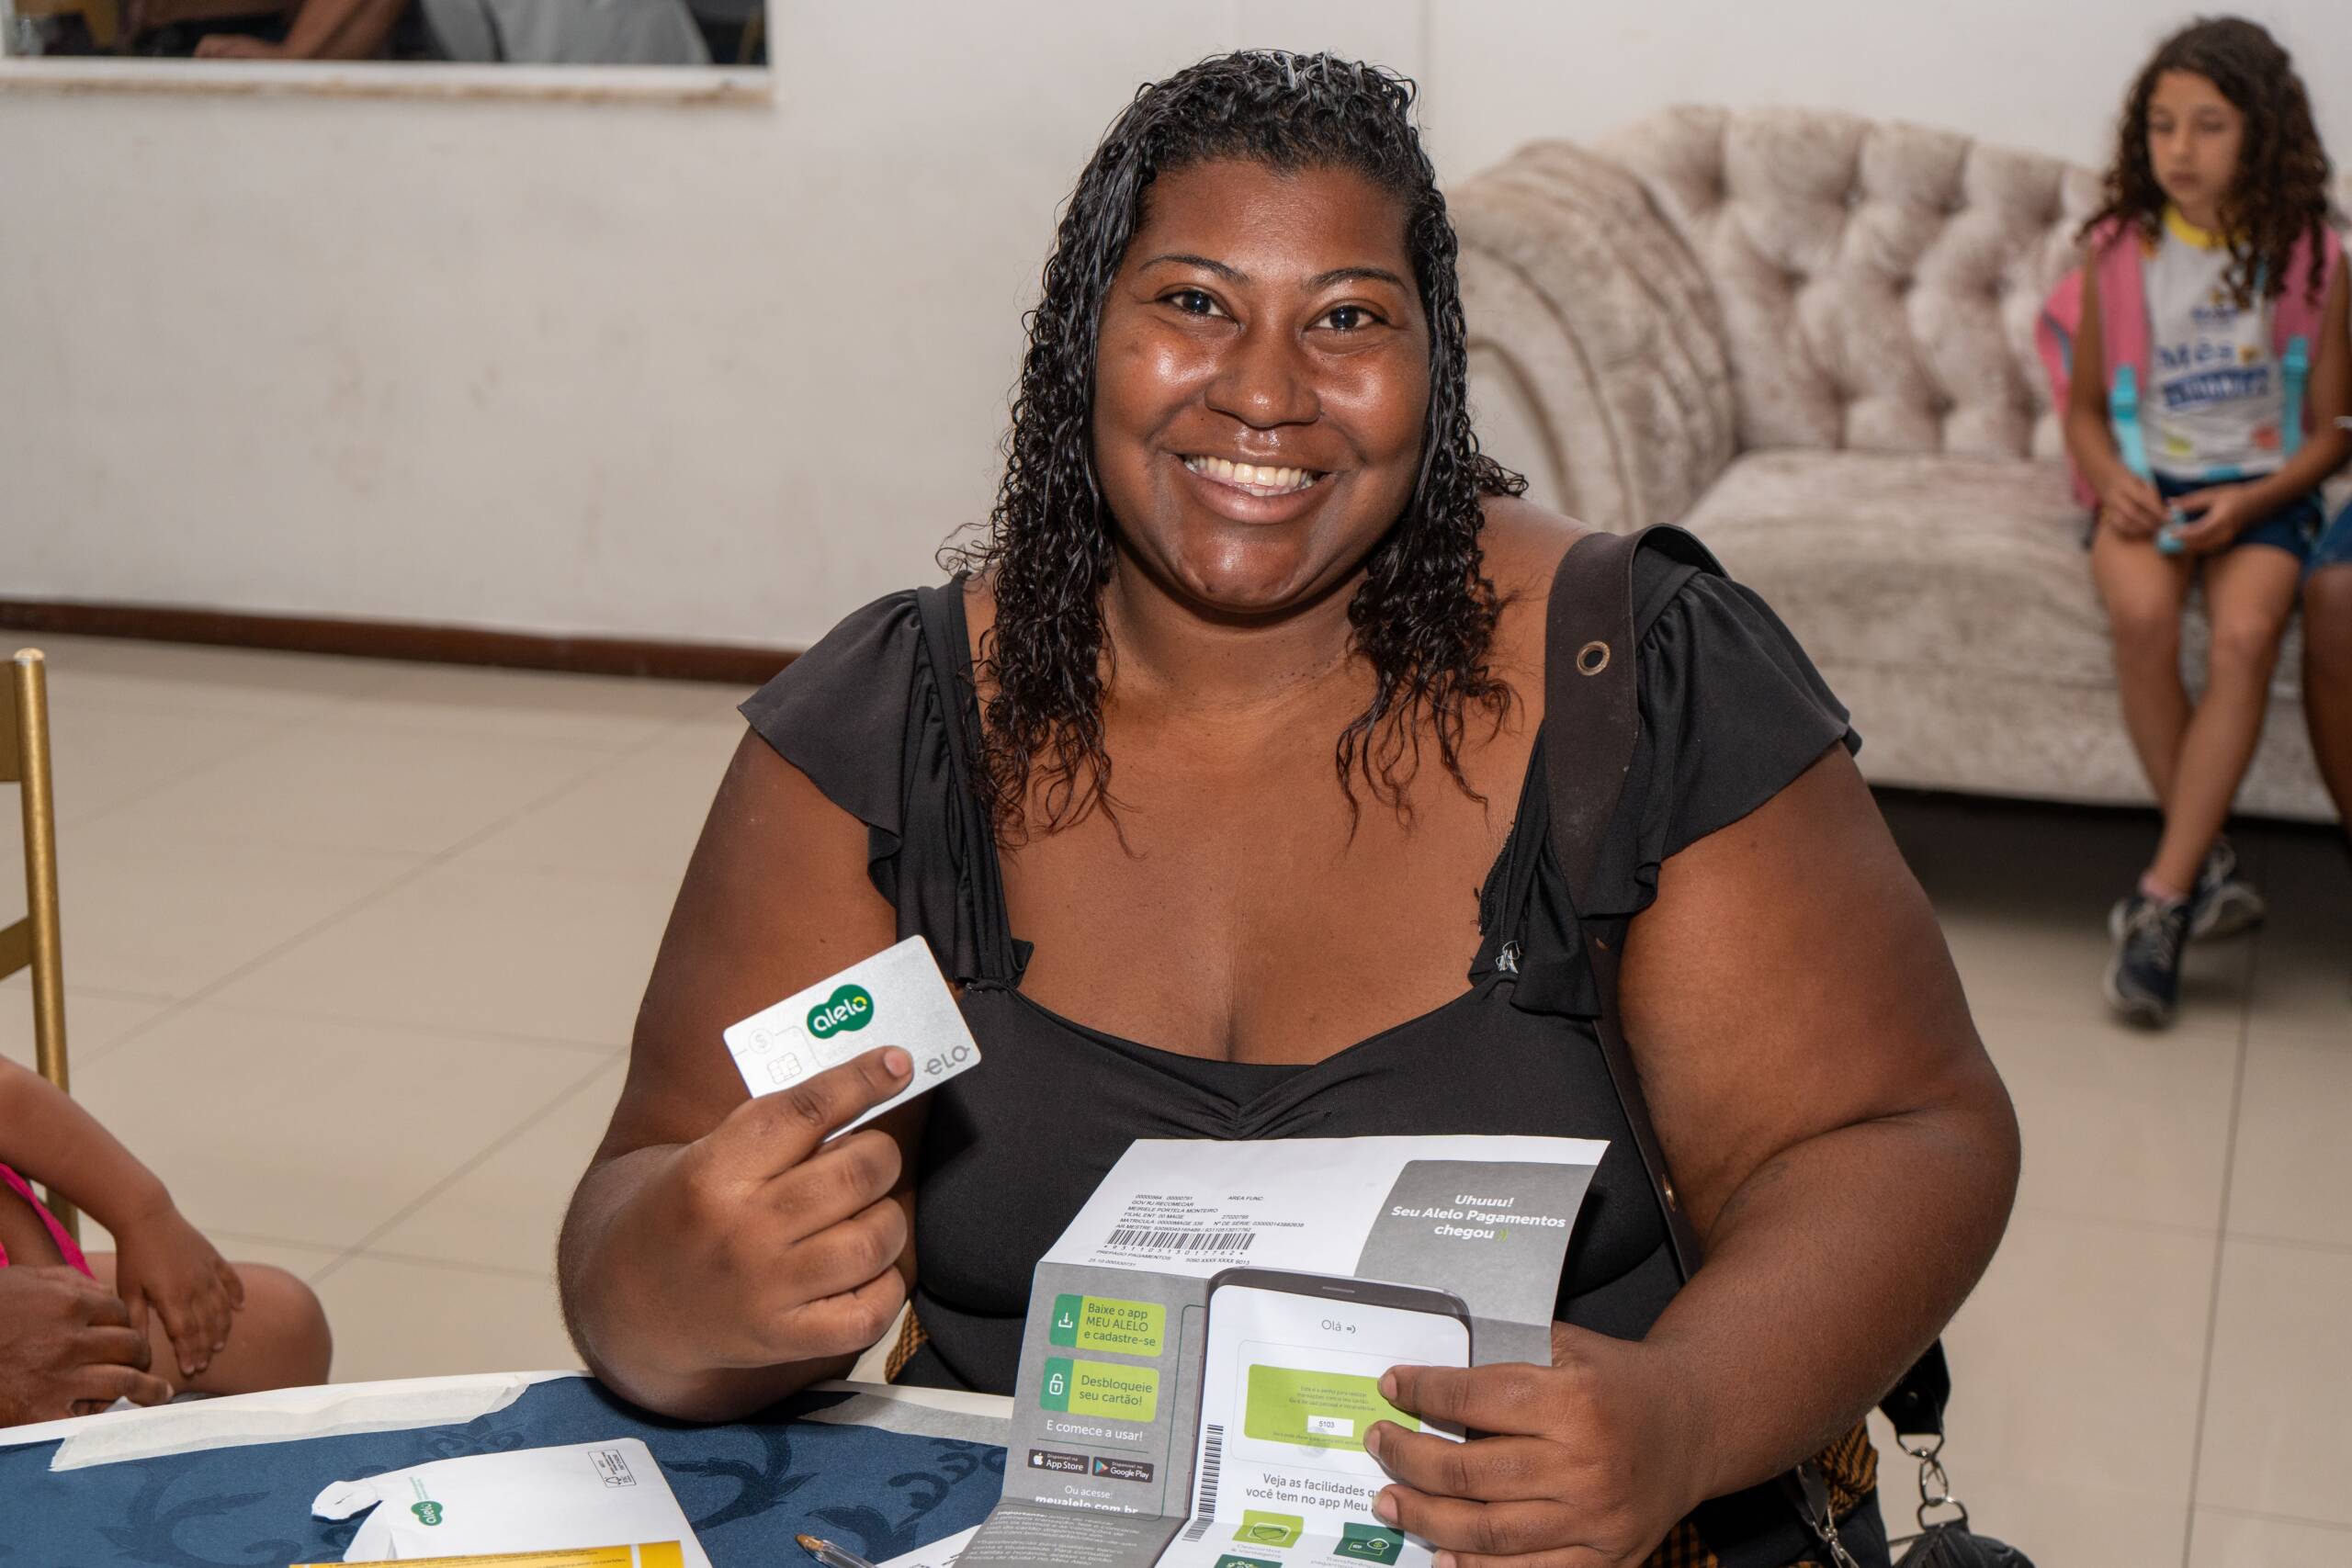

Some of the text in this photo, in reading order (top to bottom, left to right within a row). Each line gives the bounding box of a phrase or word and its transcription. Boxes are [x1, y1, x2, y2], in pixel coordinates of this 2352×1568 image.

[813, 996, 868, 1032] alelo
[1454, 1194, 1514, 1208] Uhuuu!
[1391, 1206, 1566, 1228] Seu Alelo Pagamentos
[1434, 1224, 1495, 1240] chegou
[1088, 1303, 1148, 1320] Baixe o app
[1086, 1315, 1148, 1332] MEU ALELO
[1321, 1319, 1341, 1332] Olá
[1093, 1332, 1156, 1347] cadastre-se
[1080, 1374, 1153, 1393] Desbloqueie
[1080, 1391, 1143, 1406] seu cartão!
[1046, 1419, 1143, 1441] E comece a usar!
[1046, 1459, 1084, 1472] App Store
[1110, 1467, 1149, 1480] Google Play
[1065, 1485, 1113, 1499] Ou acesse:
[1263, 1473, 1286, 1488] Veja
[1289, 1478, 1301, 1488] as
[1305, 1479, 1365, 1497] facilidades
[1246, 1487, 1368, 1512] você tem no app Meu
